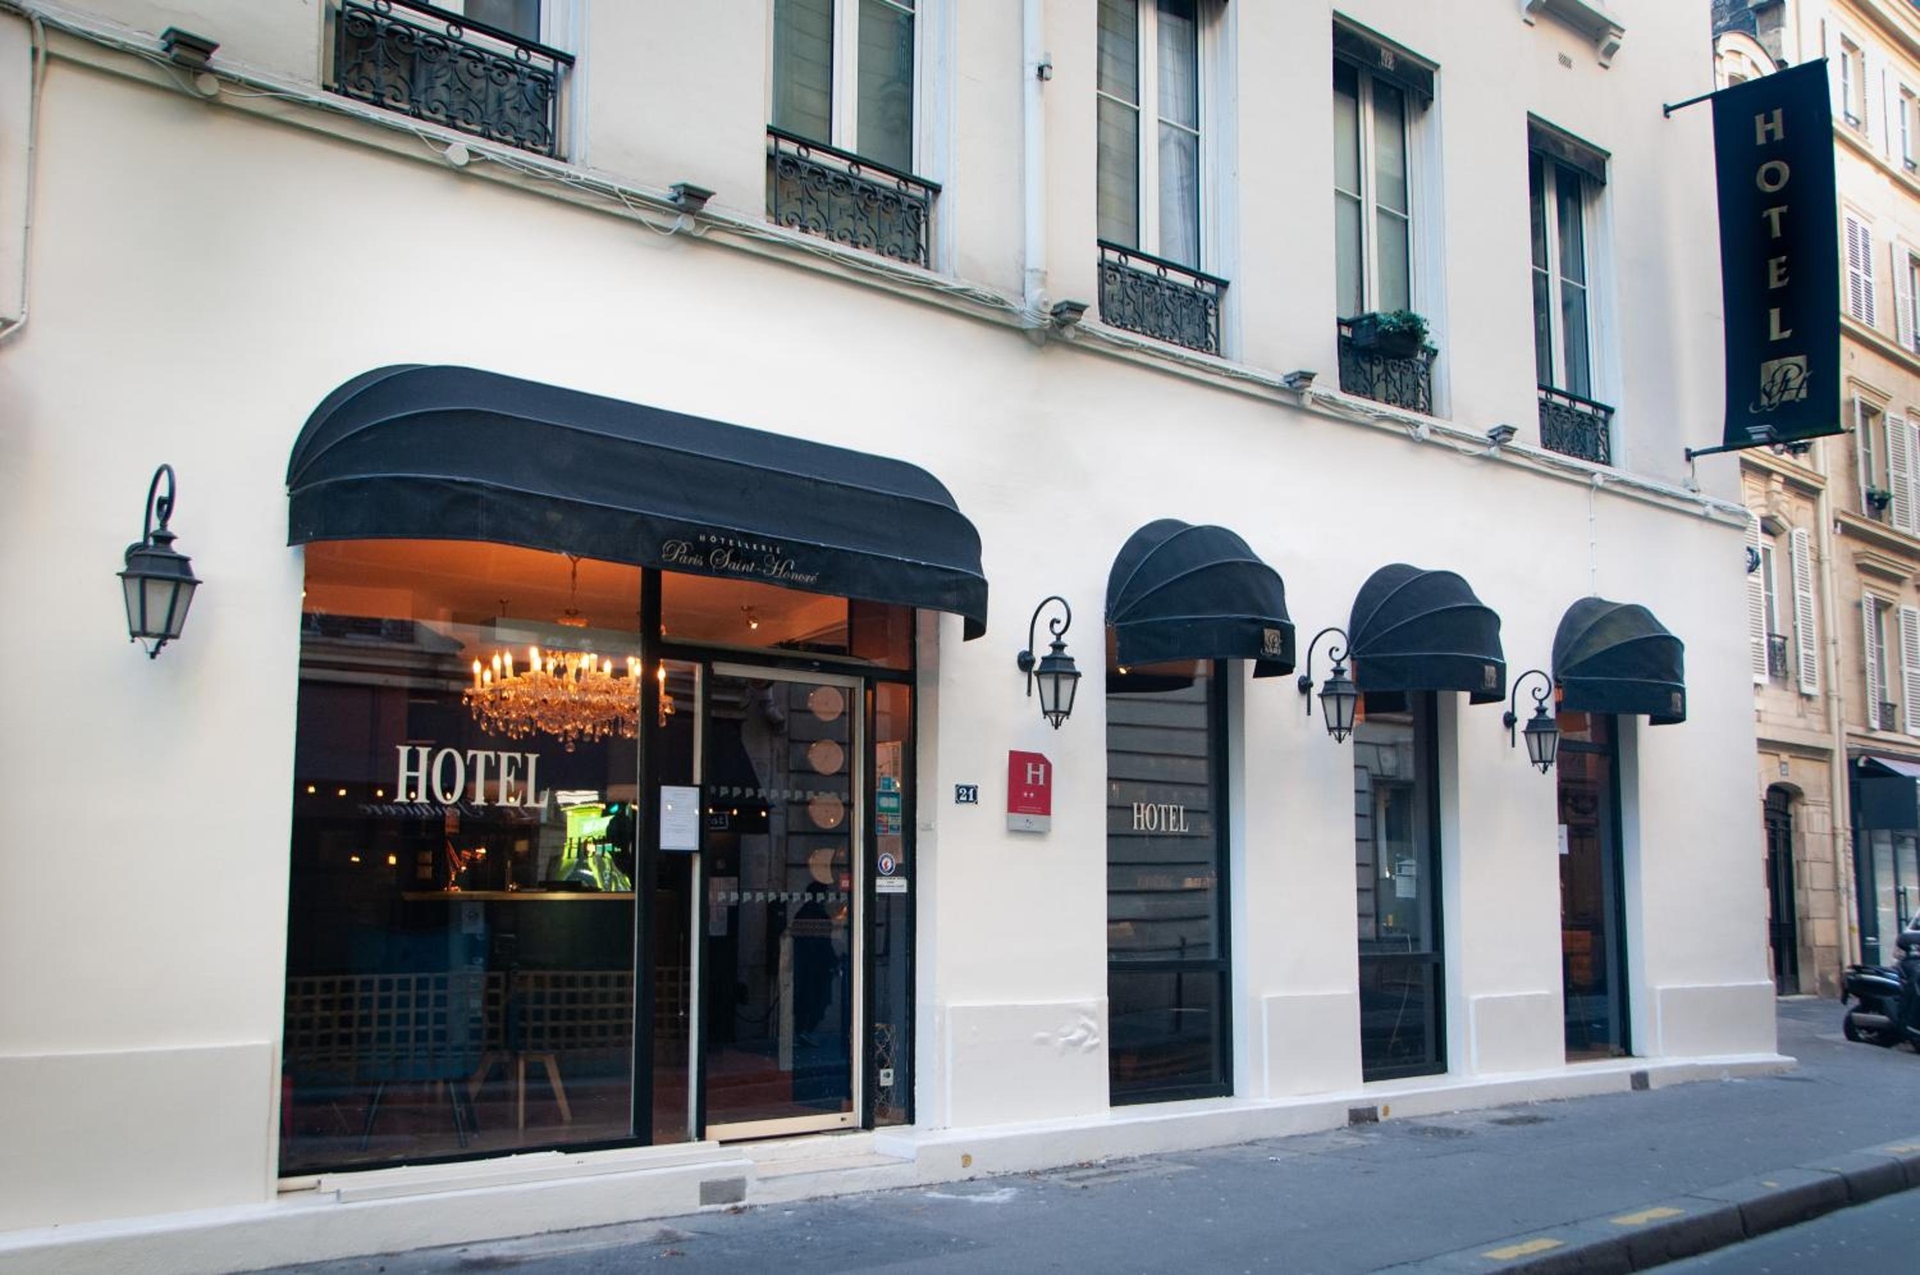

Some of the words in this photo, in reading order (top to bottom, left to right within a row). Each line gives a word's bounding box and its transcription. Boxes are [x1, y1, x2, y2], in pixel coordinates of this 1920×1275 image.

[1754, 107, 1793, 342] HOTEL
[662, 540, 704, 566] Paris
[709, 548, 819, 583] Saint-Honoré
[393, 744, 550, 808] HOTEL
[1026, 762, 1045, 786] H
[958, 787, 975, 802] 21
[1132, 802, 1189, 833] HOTEL
